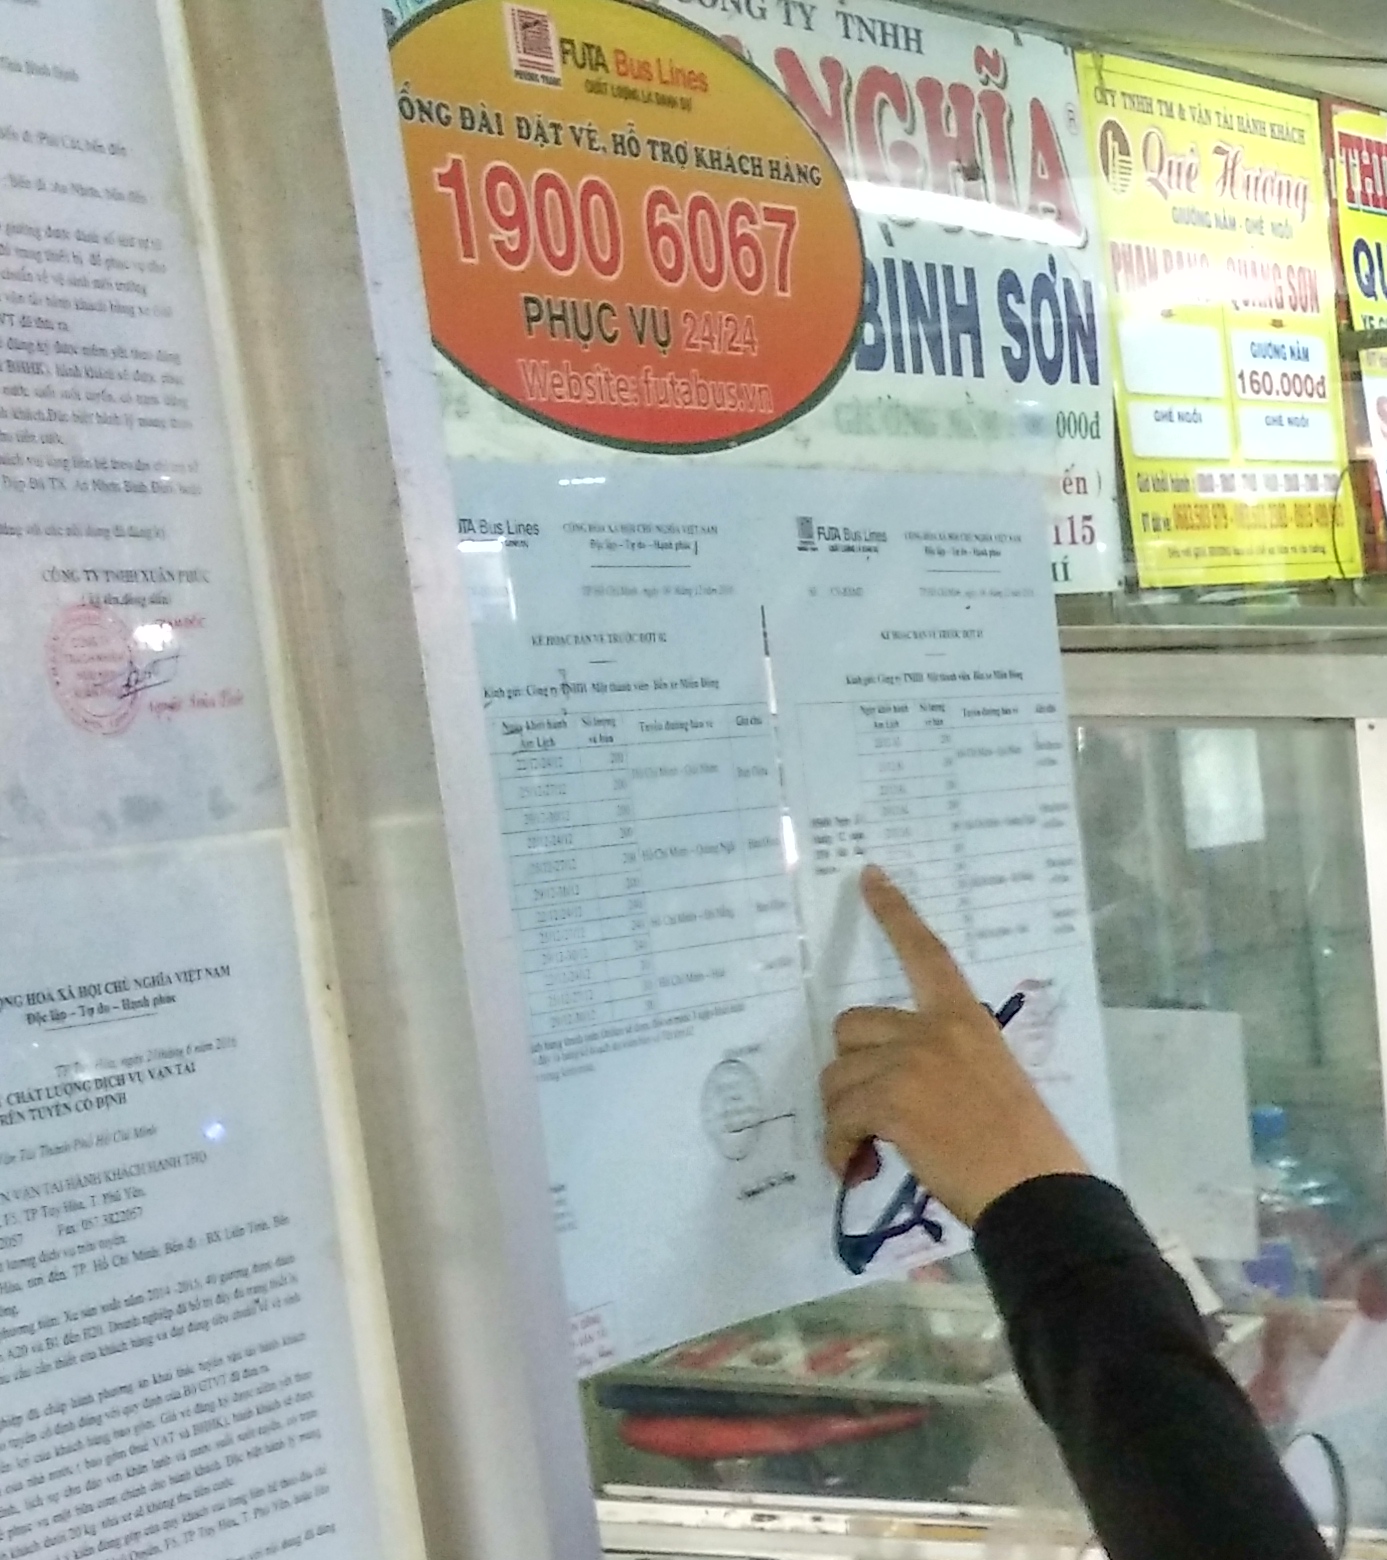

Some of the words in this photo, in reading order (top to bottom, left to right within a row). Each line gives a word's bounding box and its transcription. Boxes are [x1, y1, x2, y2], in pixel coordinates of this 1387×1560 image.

[834, 10, 925, 56] TNHH
[560, 36, 609, 76] FUTA
[613, 48, 653, 83] Bus
[655, 57, 709, 94] Lines
[458, 100, 505, 138] ĐÀI
[515, 110, 564, 150] ĐẶT
[610, 120, 642, 159] HỖ
[646, 138, 690, 171] TRỢ
[693, 142, 764, 178] KHÁCH
[768, 153, 824, 187] HÀNG
[433, 152, 624, 281] 1900
[642, 184, 800, 299] 6067
[521, 292, 620, 354] PHỤC
[628, 302, 673, 358] VỤ
[680, 310, 759, 358] 24/24
[996, 252, 1101, 386] SƠN
[517, 357, 640, 406] Website:
[642, 366, 776, 416] futabus.vn
[1237, 368, 1328, 400] 160.000đ
[506, 519, 540, 536] Lines
